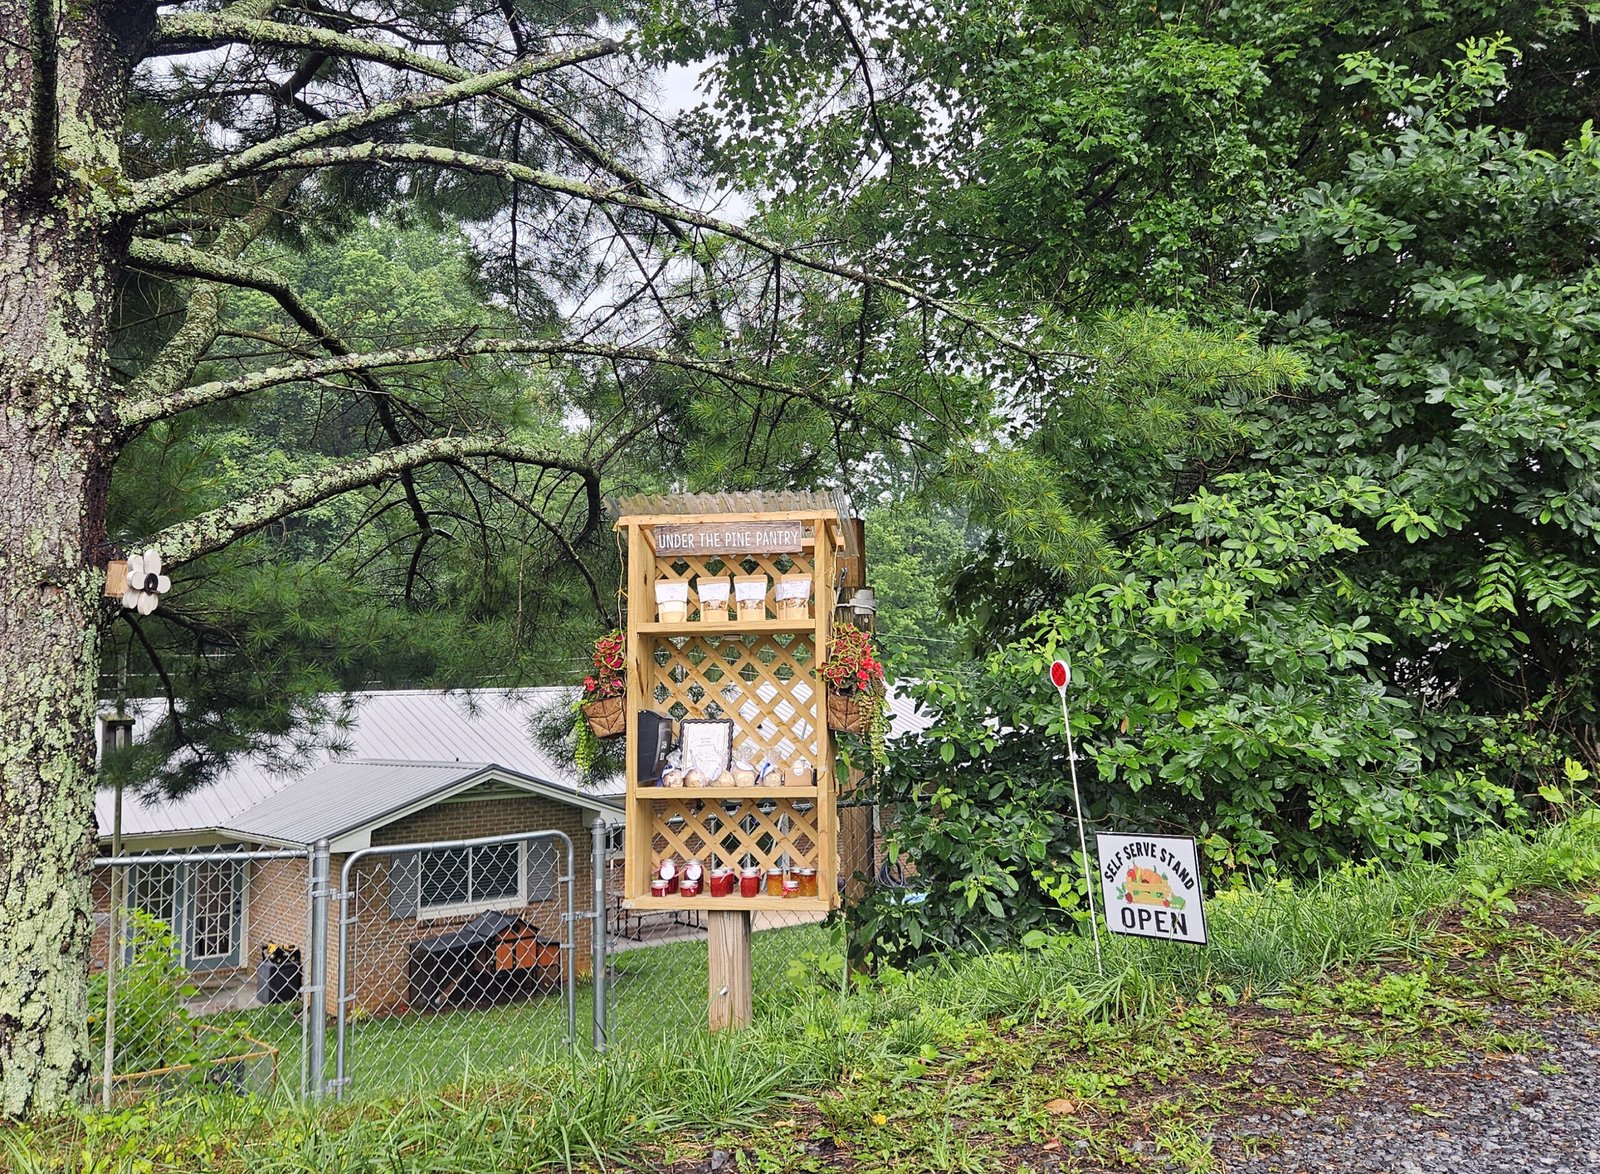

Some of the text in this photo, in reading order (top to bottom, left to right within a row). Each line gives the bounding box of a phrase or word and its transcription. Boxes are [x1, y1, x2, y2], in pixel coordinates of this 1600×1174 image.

[658, 530, 799, 549] UNDER THE PINE PANTRY
[1104, 841, 1195, 890] SELF SERVE STAND
[1121, 907, 1188, 936] OPEN
